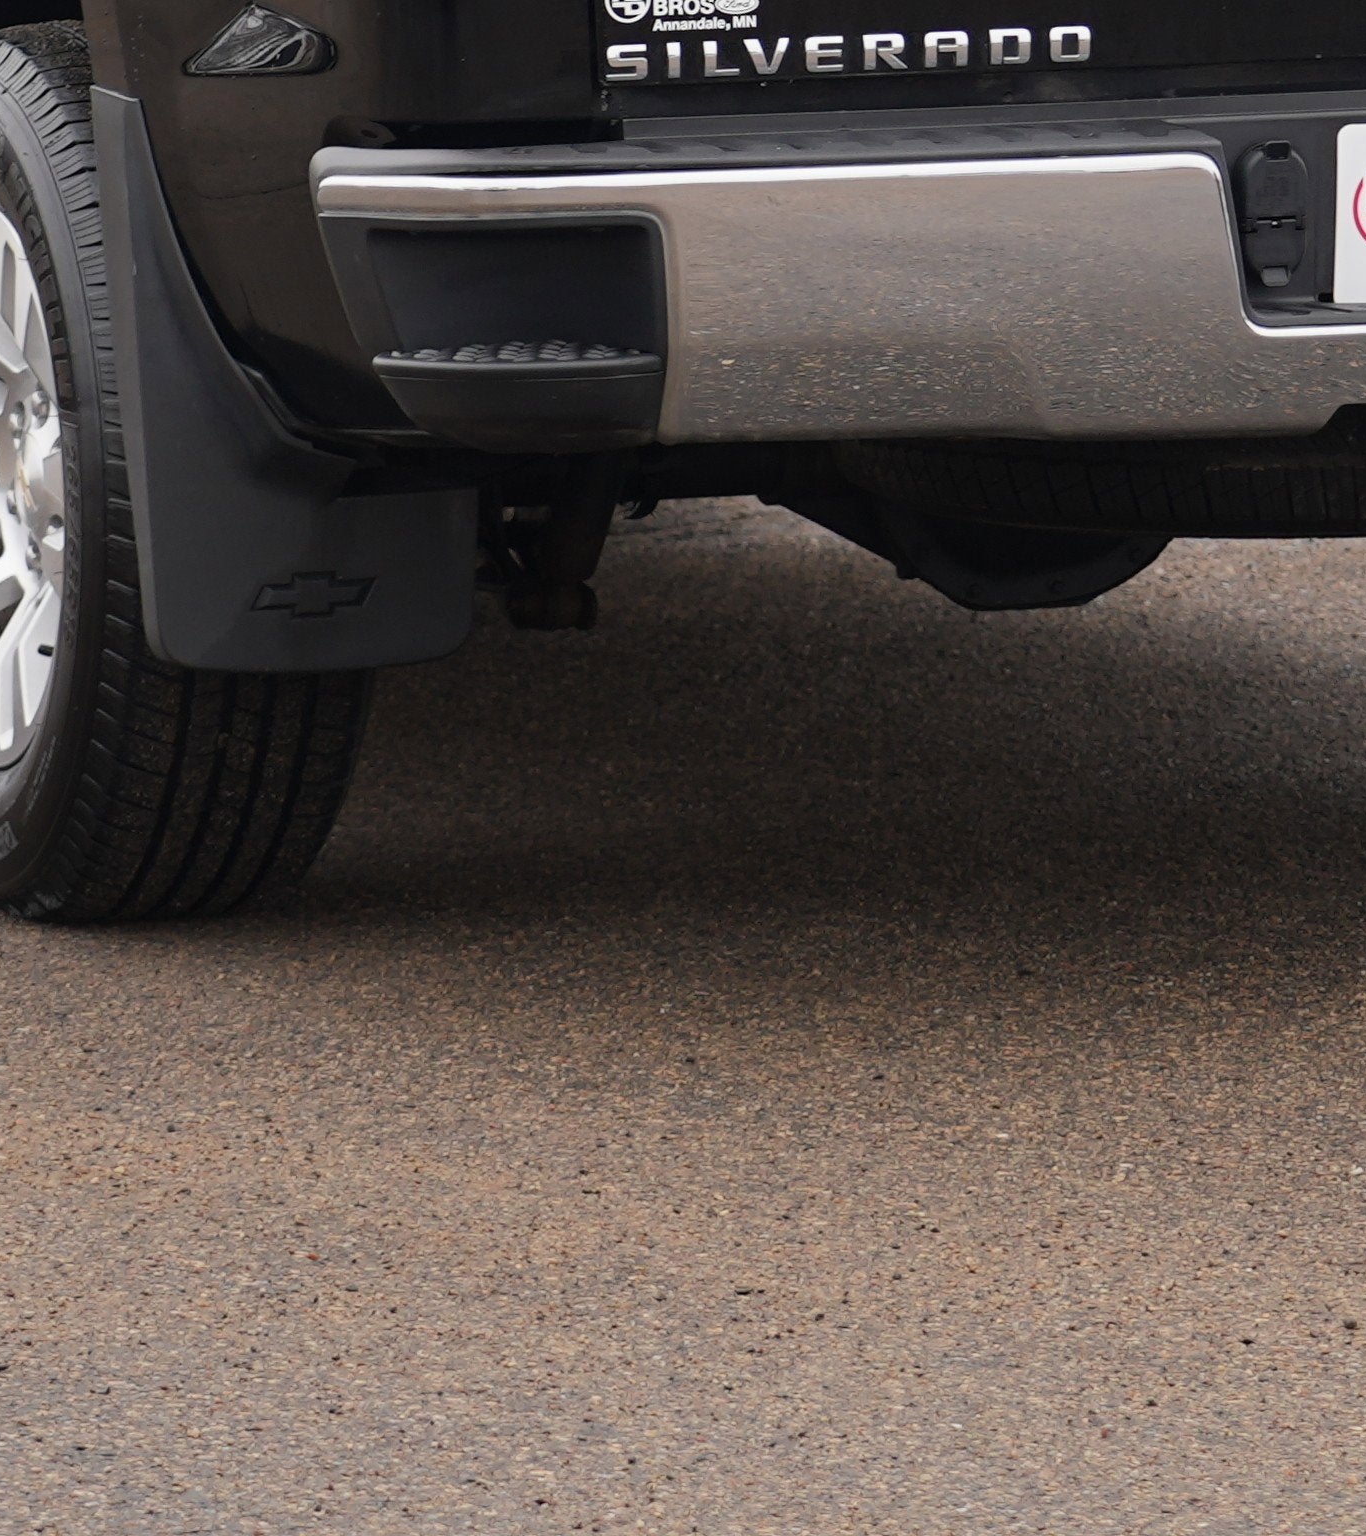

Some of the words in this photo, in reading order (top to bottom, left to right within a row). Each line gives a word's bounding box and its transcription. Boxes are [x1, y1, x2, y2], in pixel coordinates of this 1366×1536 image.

[652, 16, 731, 32] Annandale,
[732, 14, 757, 28] MN
[605, 25, 1092, 82] SILVERADO
